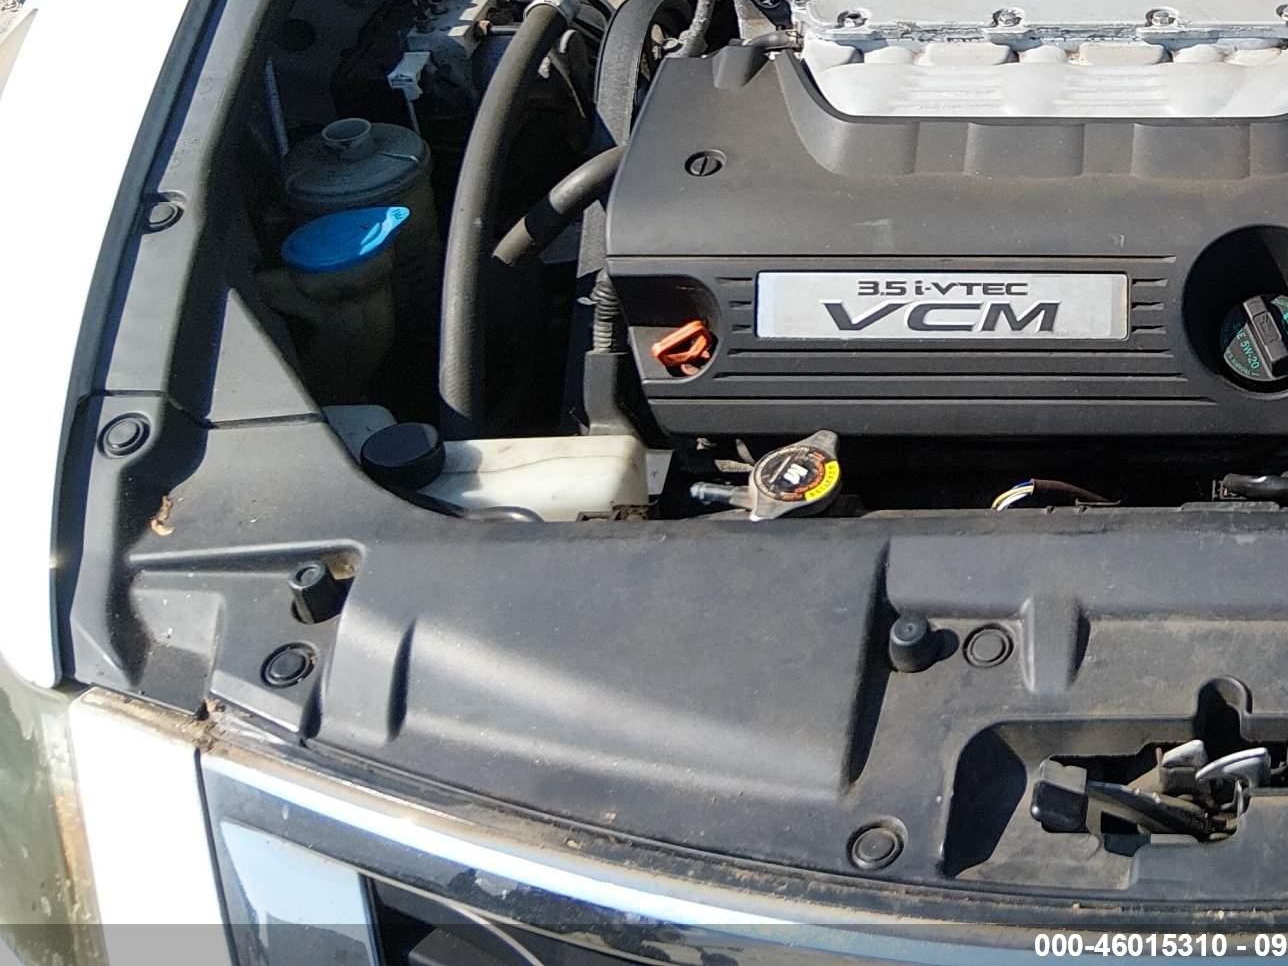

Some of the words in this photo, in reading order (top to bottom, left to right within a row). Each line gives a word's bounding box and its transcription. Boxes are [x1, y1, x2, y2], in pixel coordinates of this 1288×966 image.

[858, 281, 907, 296] 3.5
[915, 280, 1029, 296] i-VTEC
[821, 300, 1061, 332] VCM
[1240, 340, 1260, 369] 5W-20
